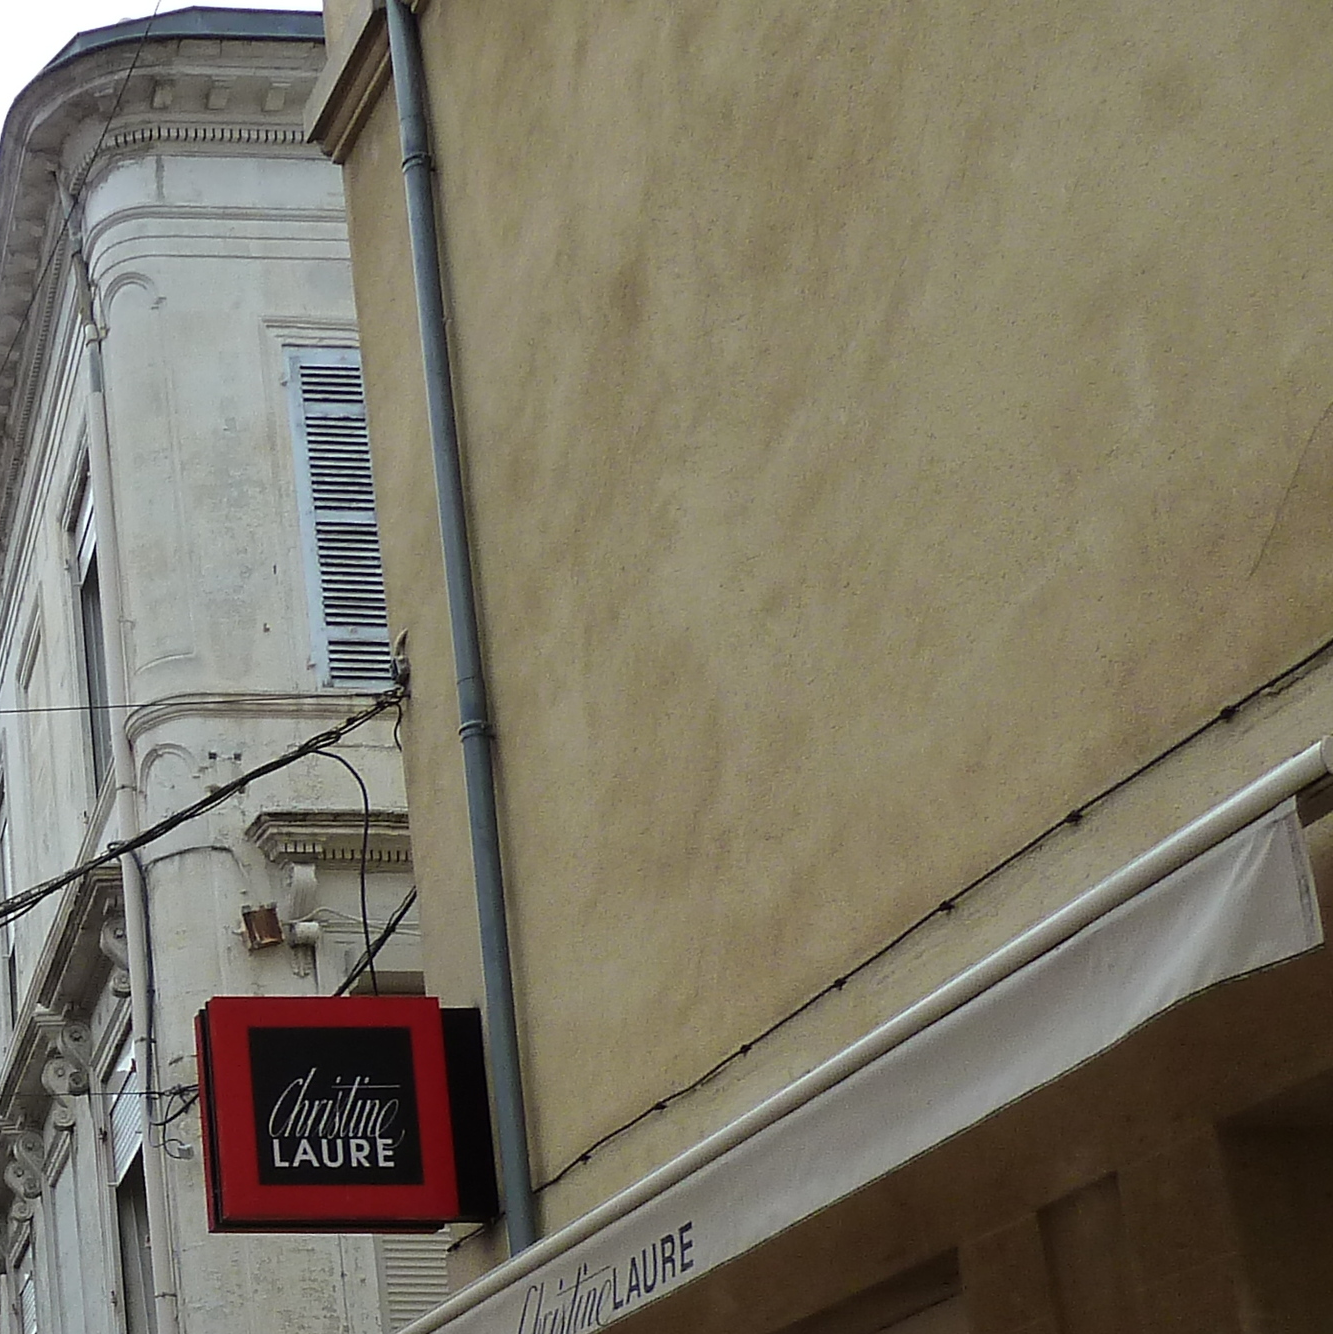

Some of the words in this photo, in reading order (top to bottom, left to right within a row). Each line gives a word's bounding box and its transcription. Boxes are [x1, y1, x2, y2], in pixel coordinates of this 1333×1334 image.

[269, 1067, 405, 1147] Christine
[272, 1139, 395, 1168] LAURE
[612, 1221, 694, 1310] LAURE
